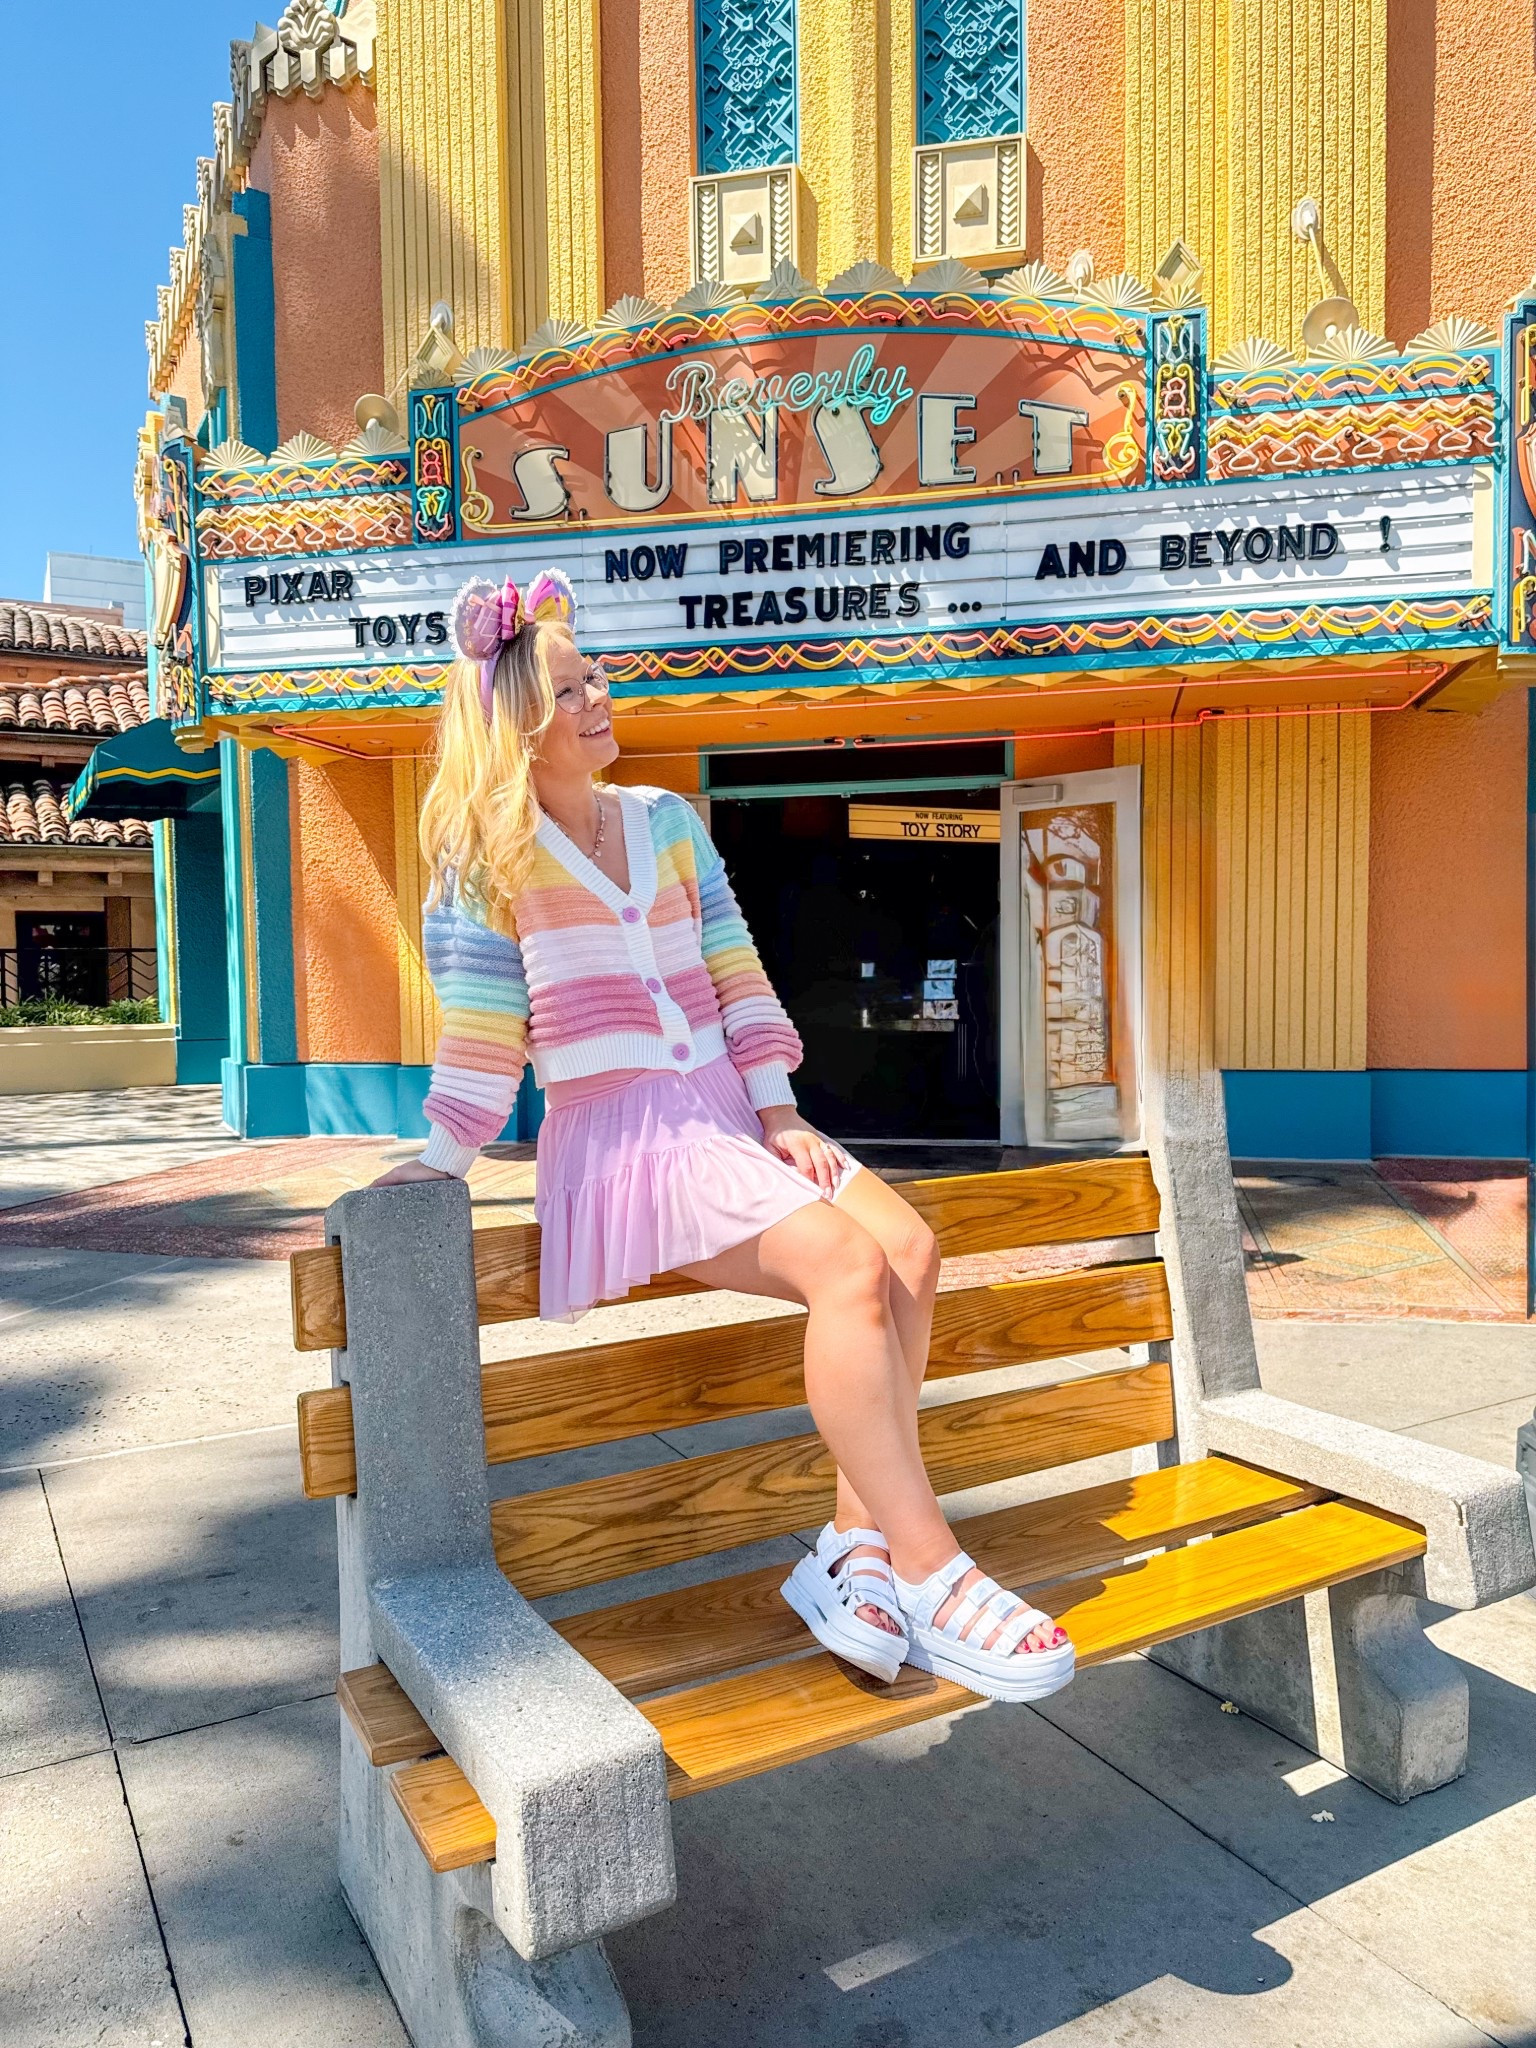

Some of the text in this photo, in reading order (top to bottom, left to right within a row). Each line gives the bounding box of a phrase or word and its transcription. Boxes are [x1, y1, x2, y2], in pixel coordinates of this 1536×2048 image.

[660, 345, 913, 425] Beverly
[508, 392, 1089, 521] SUNSET
[604, 522, 971, 584] NOW PREMIERING
[1035, 515, 1391, 580] AND BEYOND !
[244, 570, 354, 607] PIXAR
[678, 581, 921, 629] TREASURES
[350, 611, 447, 648] TOYS
[901, 822, 981, 838] TOY STORY
[915, 812, 963, 821] NOW FEATURING
